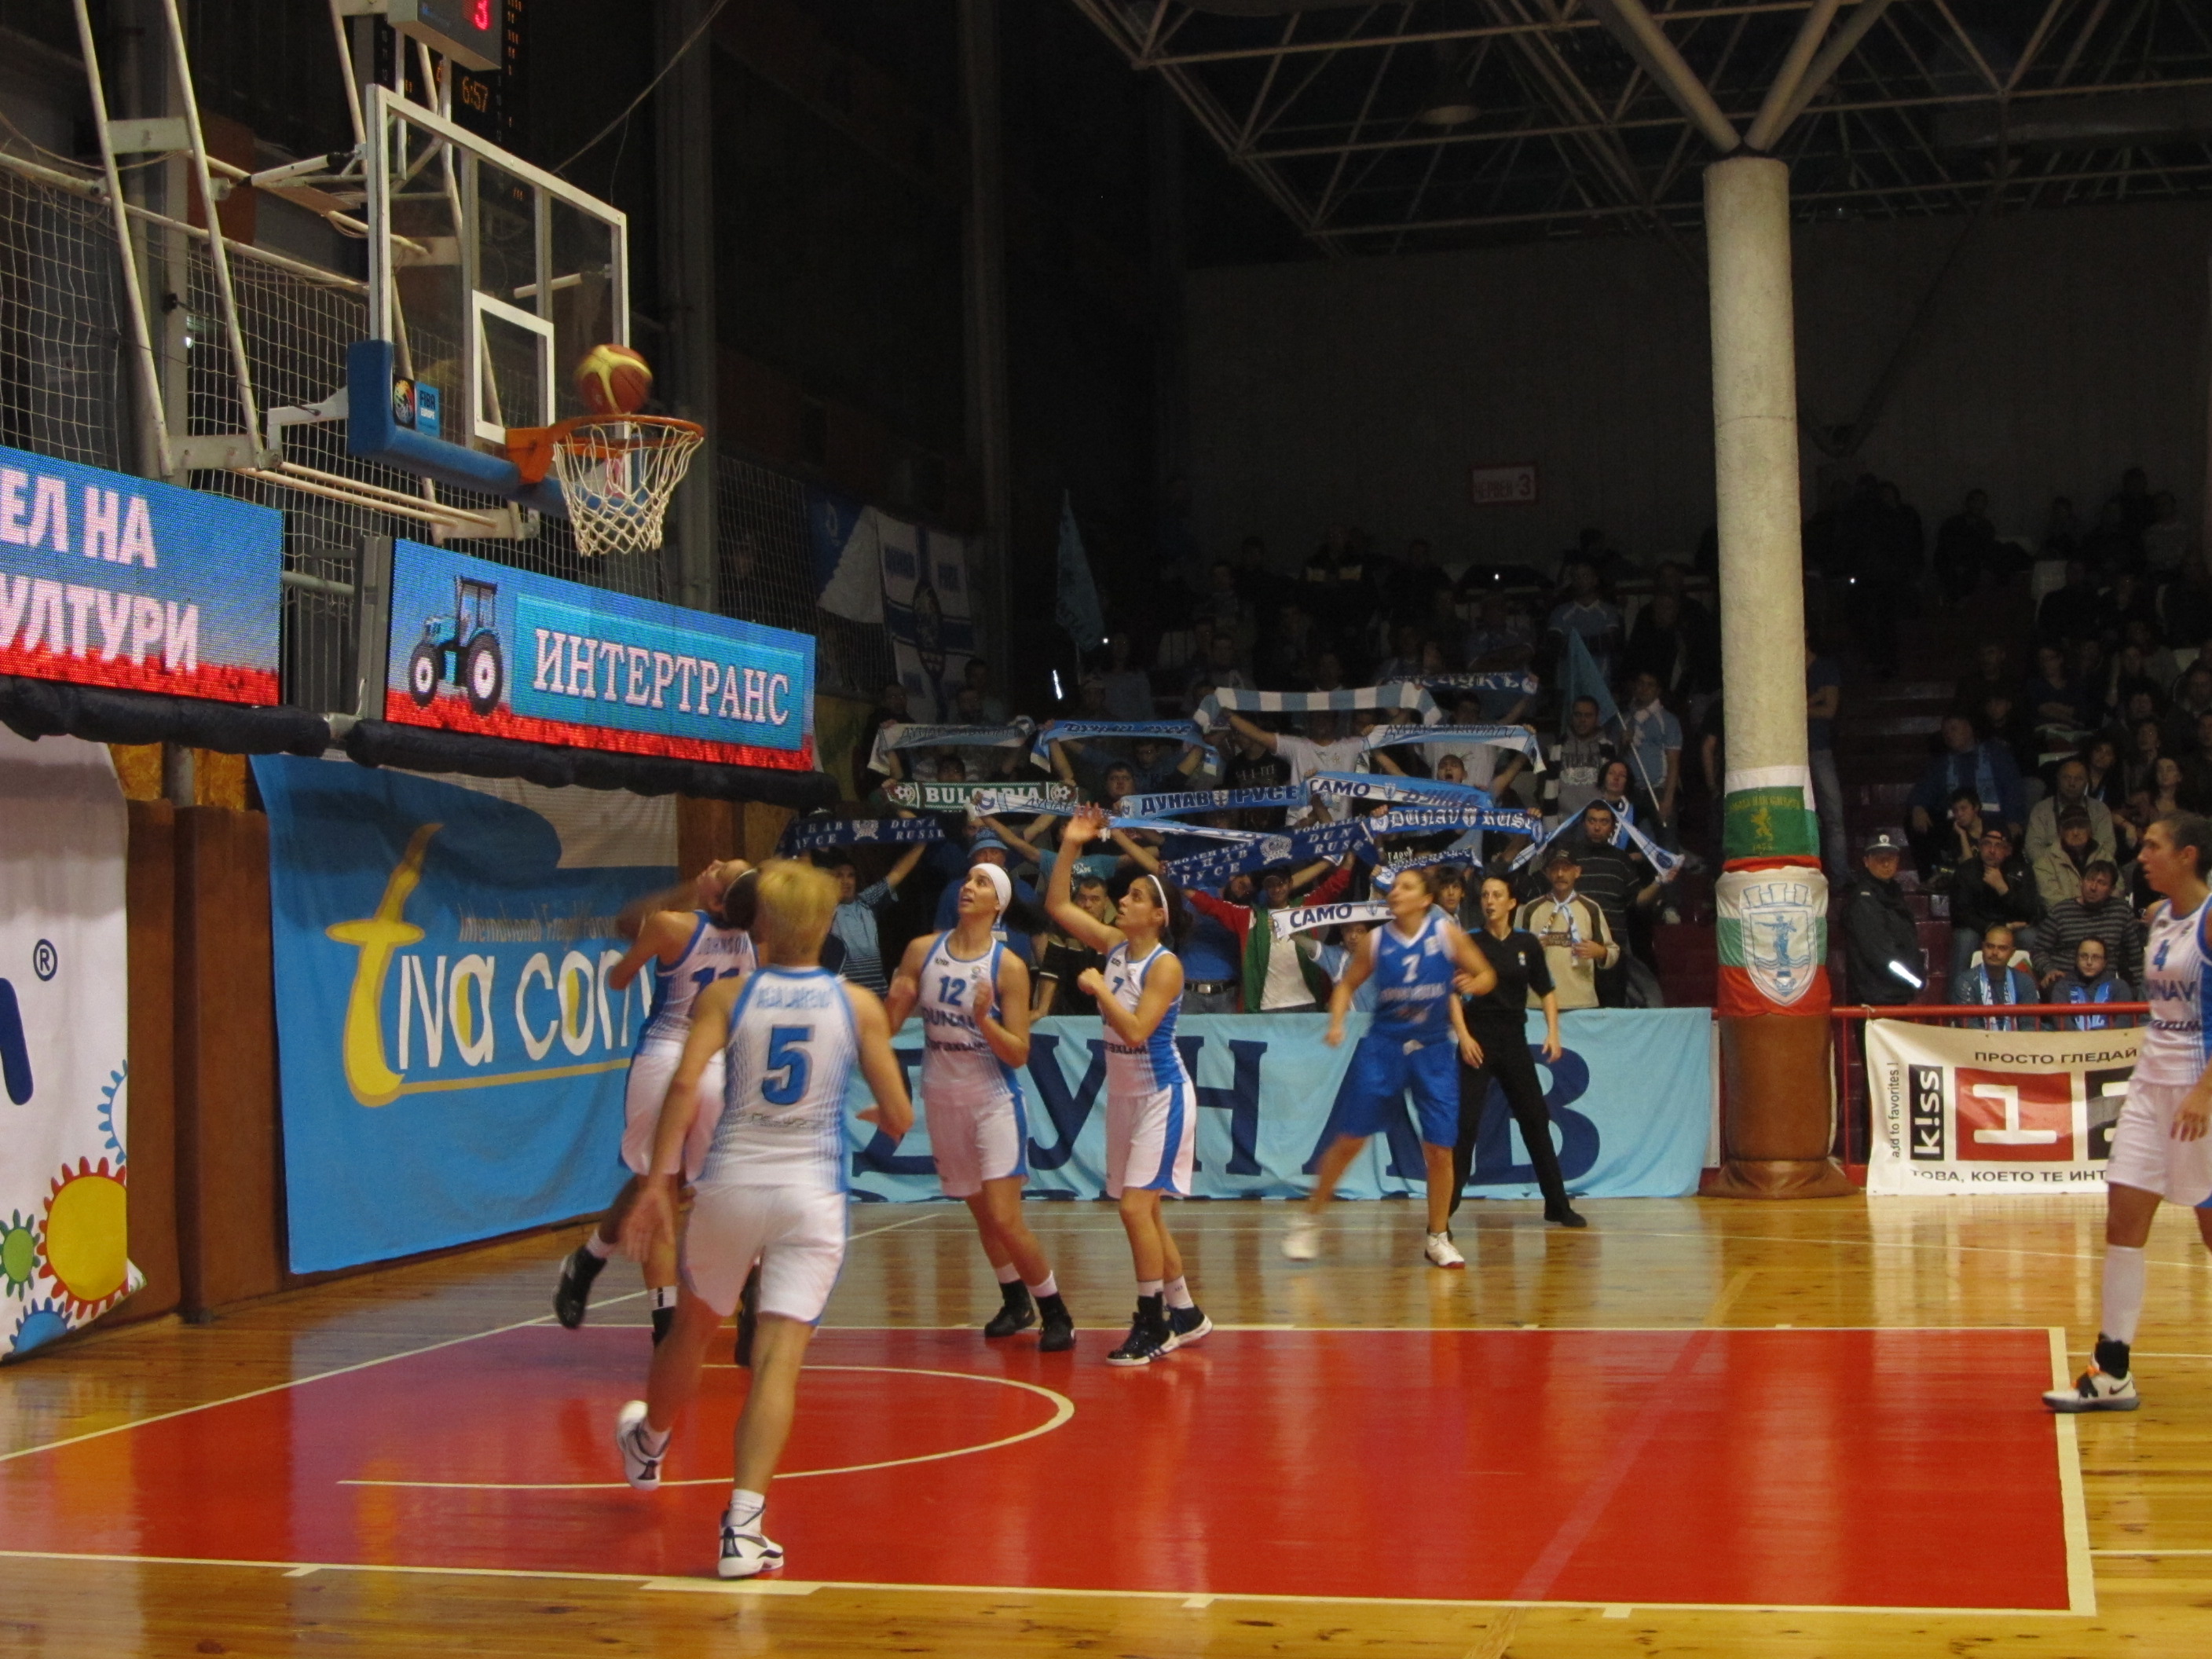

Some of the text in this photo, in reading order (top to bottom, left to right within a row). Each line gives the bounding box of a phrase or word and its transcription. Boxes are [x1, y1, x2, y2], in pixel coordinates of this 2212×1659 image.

[462, 76, 489, 112] 6:57
[82, 485, 157, 569] НА
[533, 628, 789, 726] ИНТЕРТРАНС
[925, 786, 1041, 804] BULIA
[1140, 790, 1211, 816] ДУНАВ
[1234, 785, 1299, 804] РУСЕ
[1388, 808, 1460, 829] DUNAV
[1182, 862, 1240, 885] РУСЕ
[1289, 903, 1353, 928] САМО
[2153, 939, 2170, 972] 4
[939, 976, 967, 1007] 12
[761, 1024, 815, 1106] 5
[1975, 1047, 2137, 1064] ПРОСТО ГЛЕДАЙ
[1887, 1069, 1900, 1120] favorites
[1890, 1122, 1899, 1137] to
[1890, 1138, 1900, 1158] add
[1910, 1169, 2108, 1183] ТОВА, КОЕТО ТЕ ИНТ
